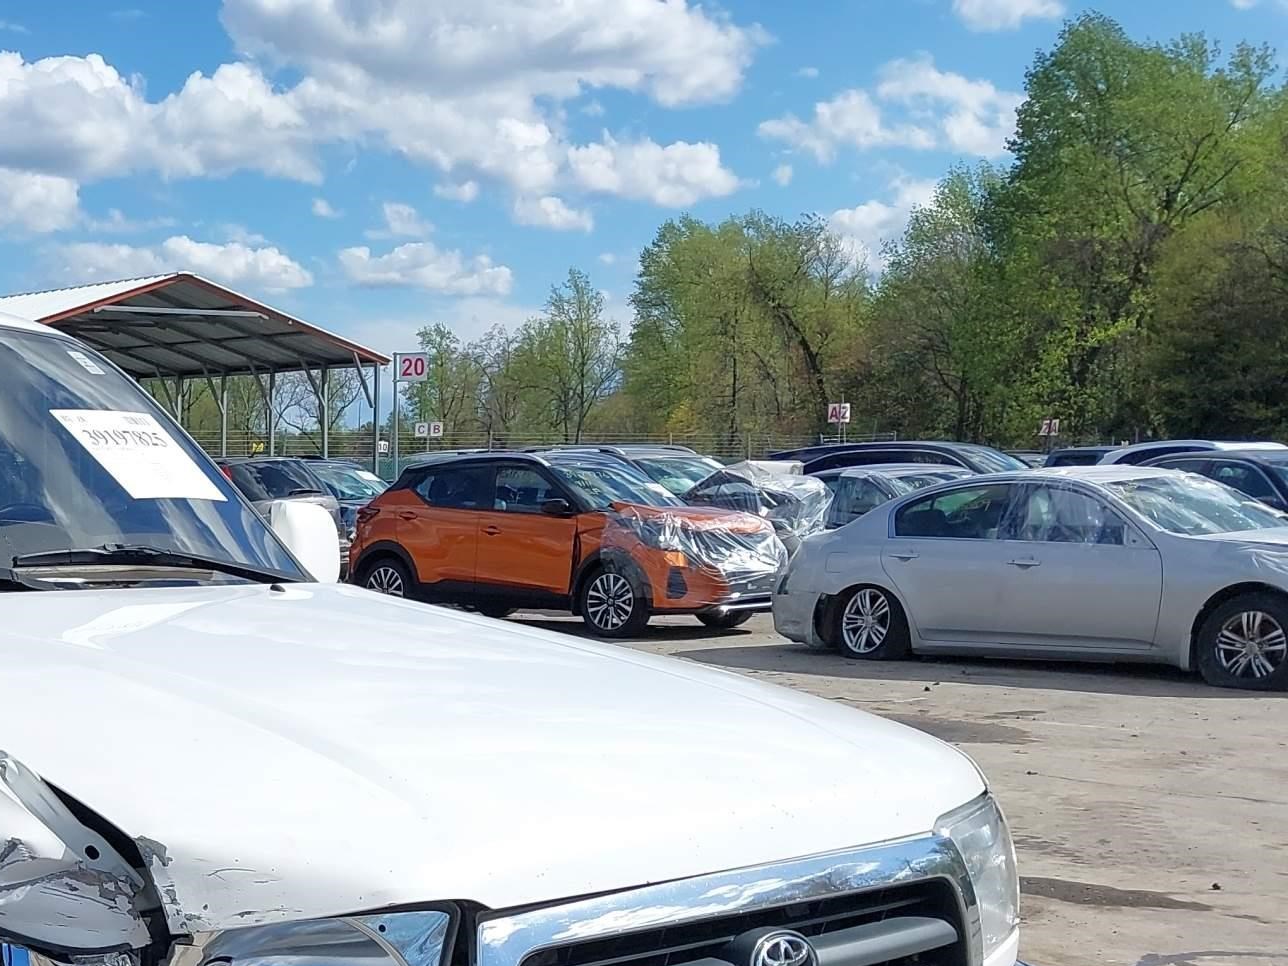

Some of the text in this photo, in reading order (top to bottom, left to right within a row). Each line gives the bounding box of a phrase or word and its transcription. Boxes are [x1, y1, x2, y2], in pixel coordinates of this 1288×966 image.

[401, 357, 425, 377] 20
[82, 428, 168, 448] 39197825
[417, 424, 441, 435] C B
